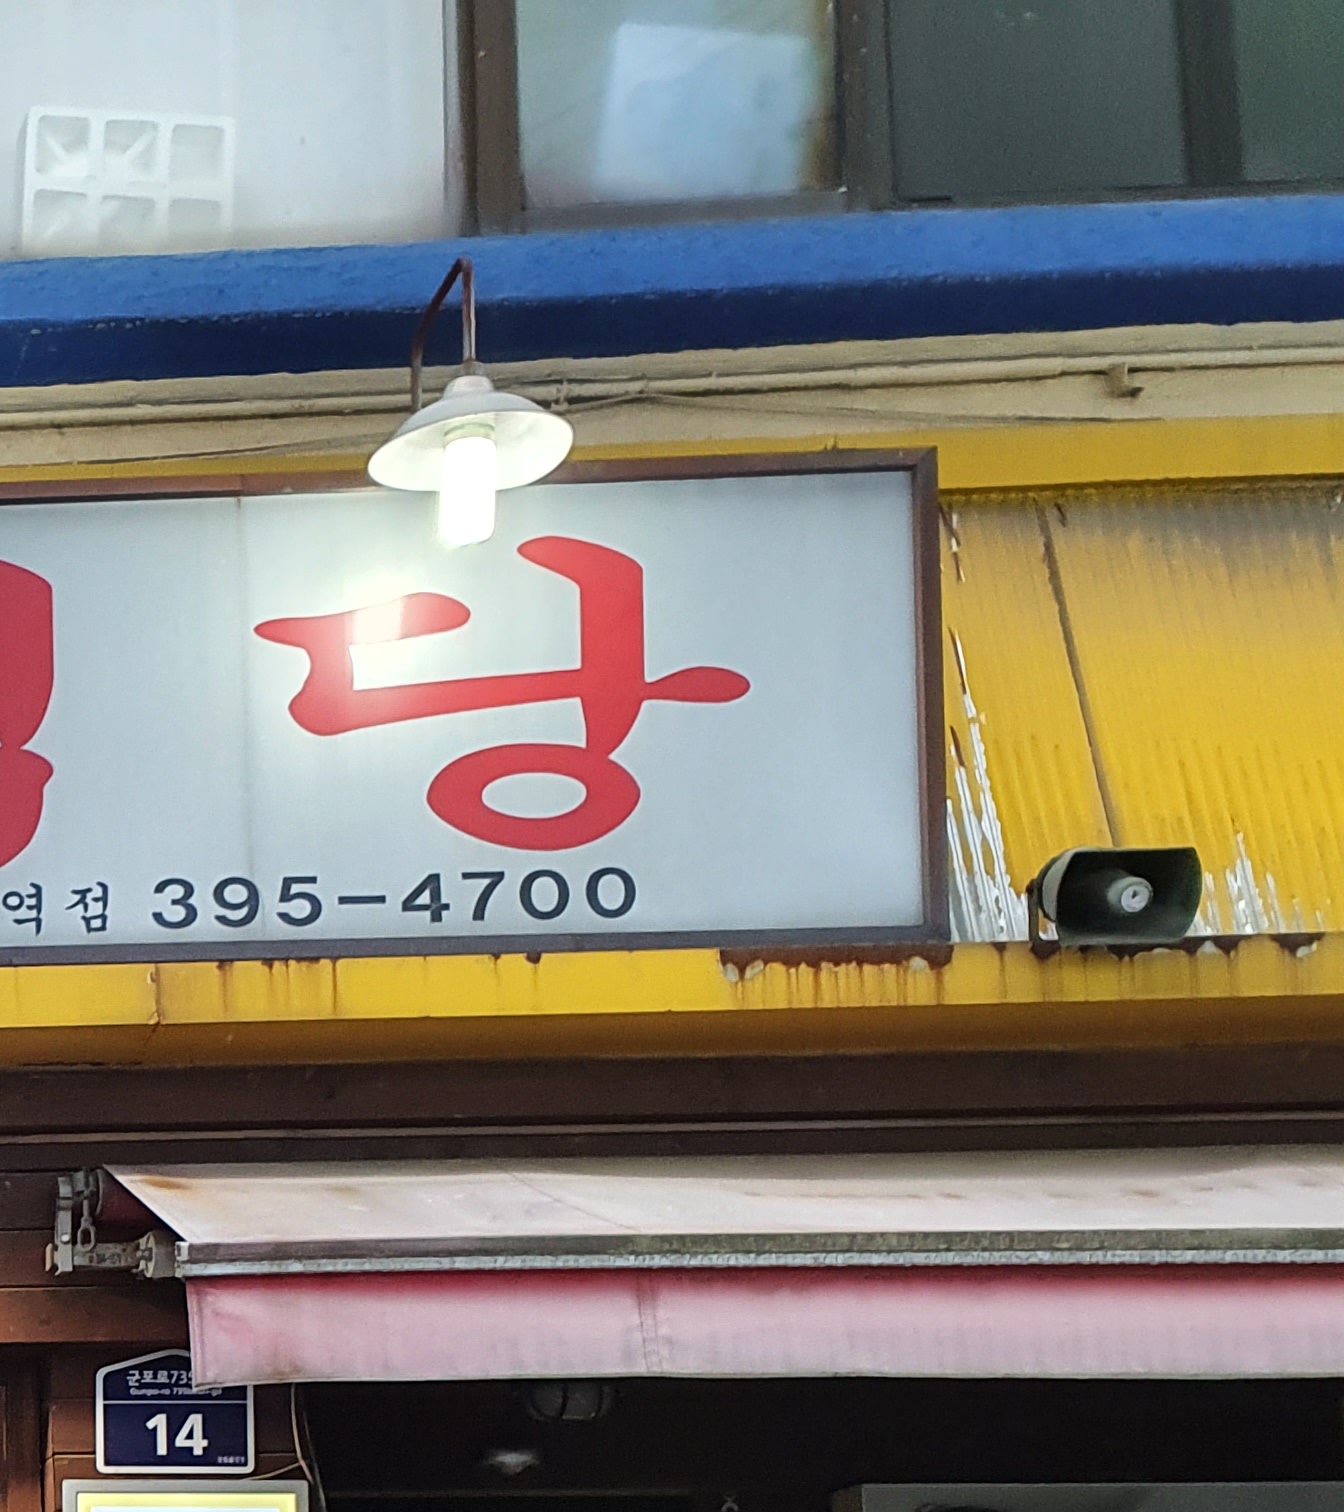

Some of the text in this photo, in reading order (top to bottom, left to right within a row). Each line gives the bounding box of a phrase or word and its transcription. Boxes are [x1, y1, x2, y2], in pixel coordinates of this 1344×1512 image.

[150, 866, 639, 930] 395-4700
[126, 1370, 193, 1386] 군포로73
[146, 1413, 208, 1456] 14
